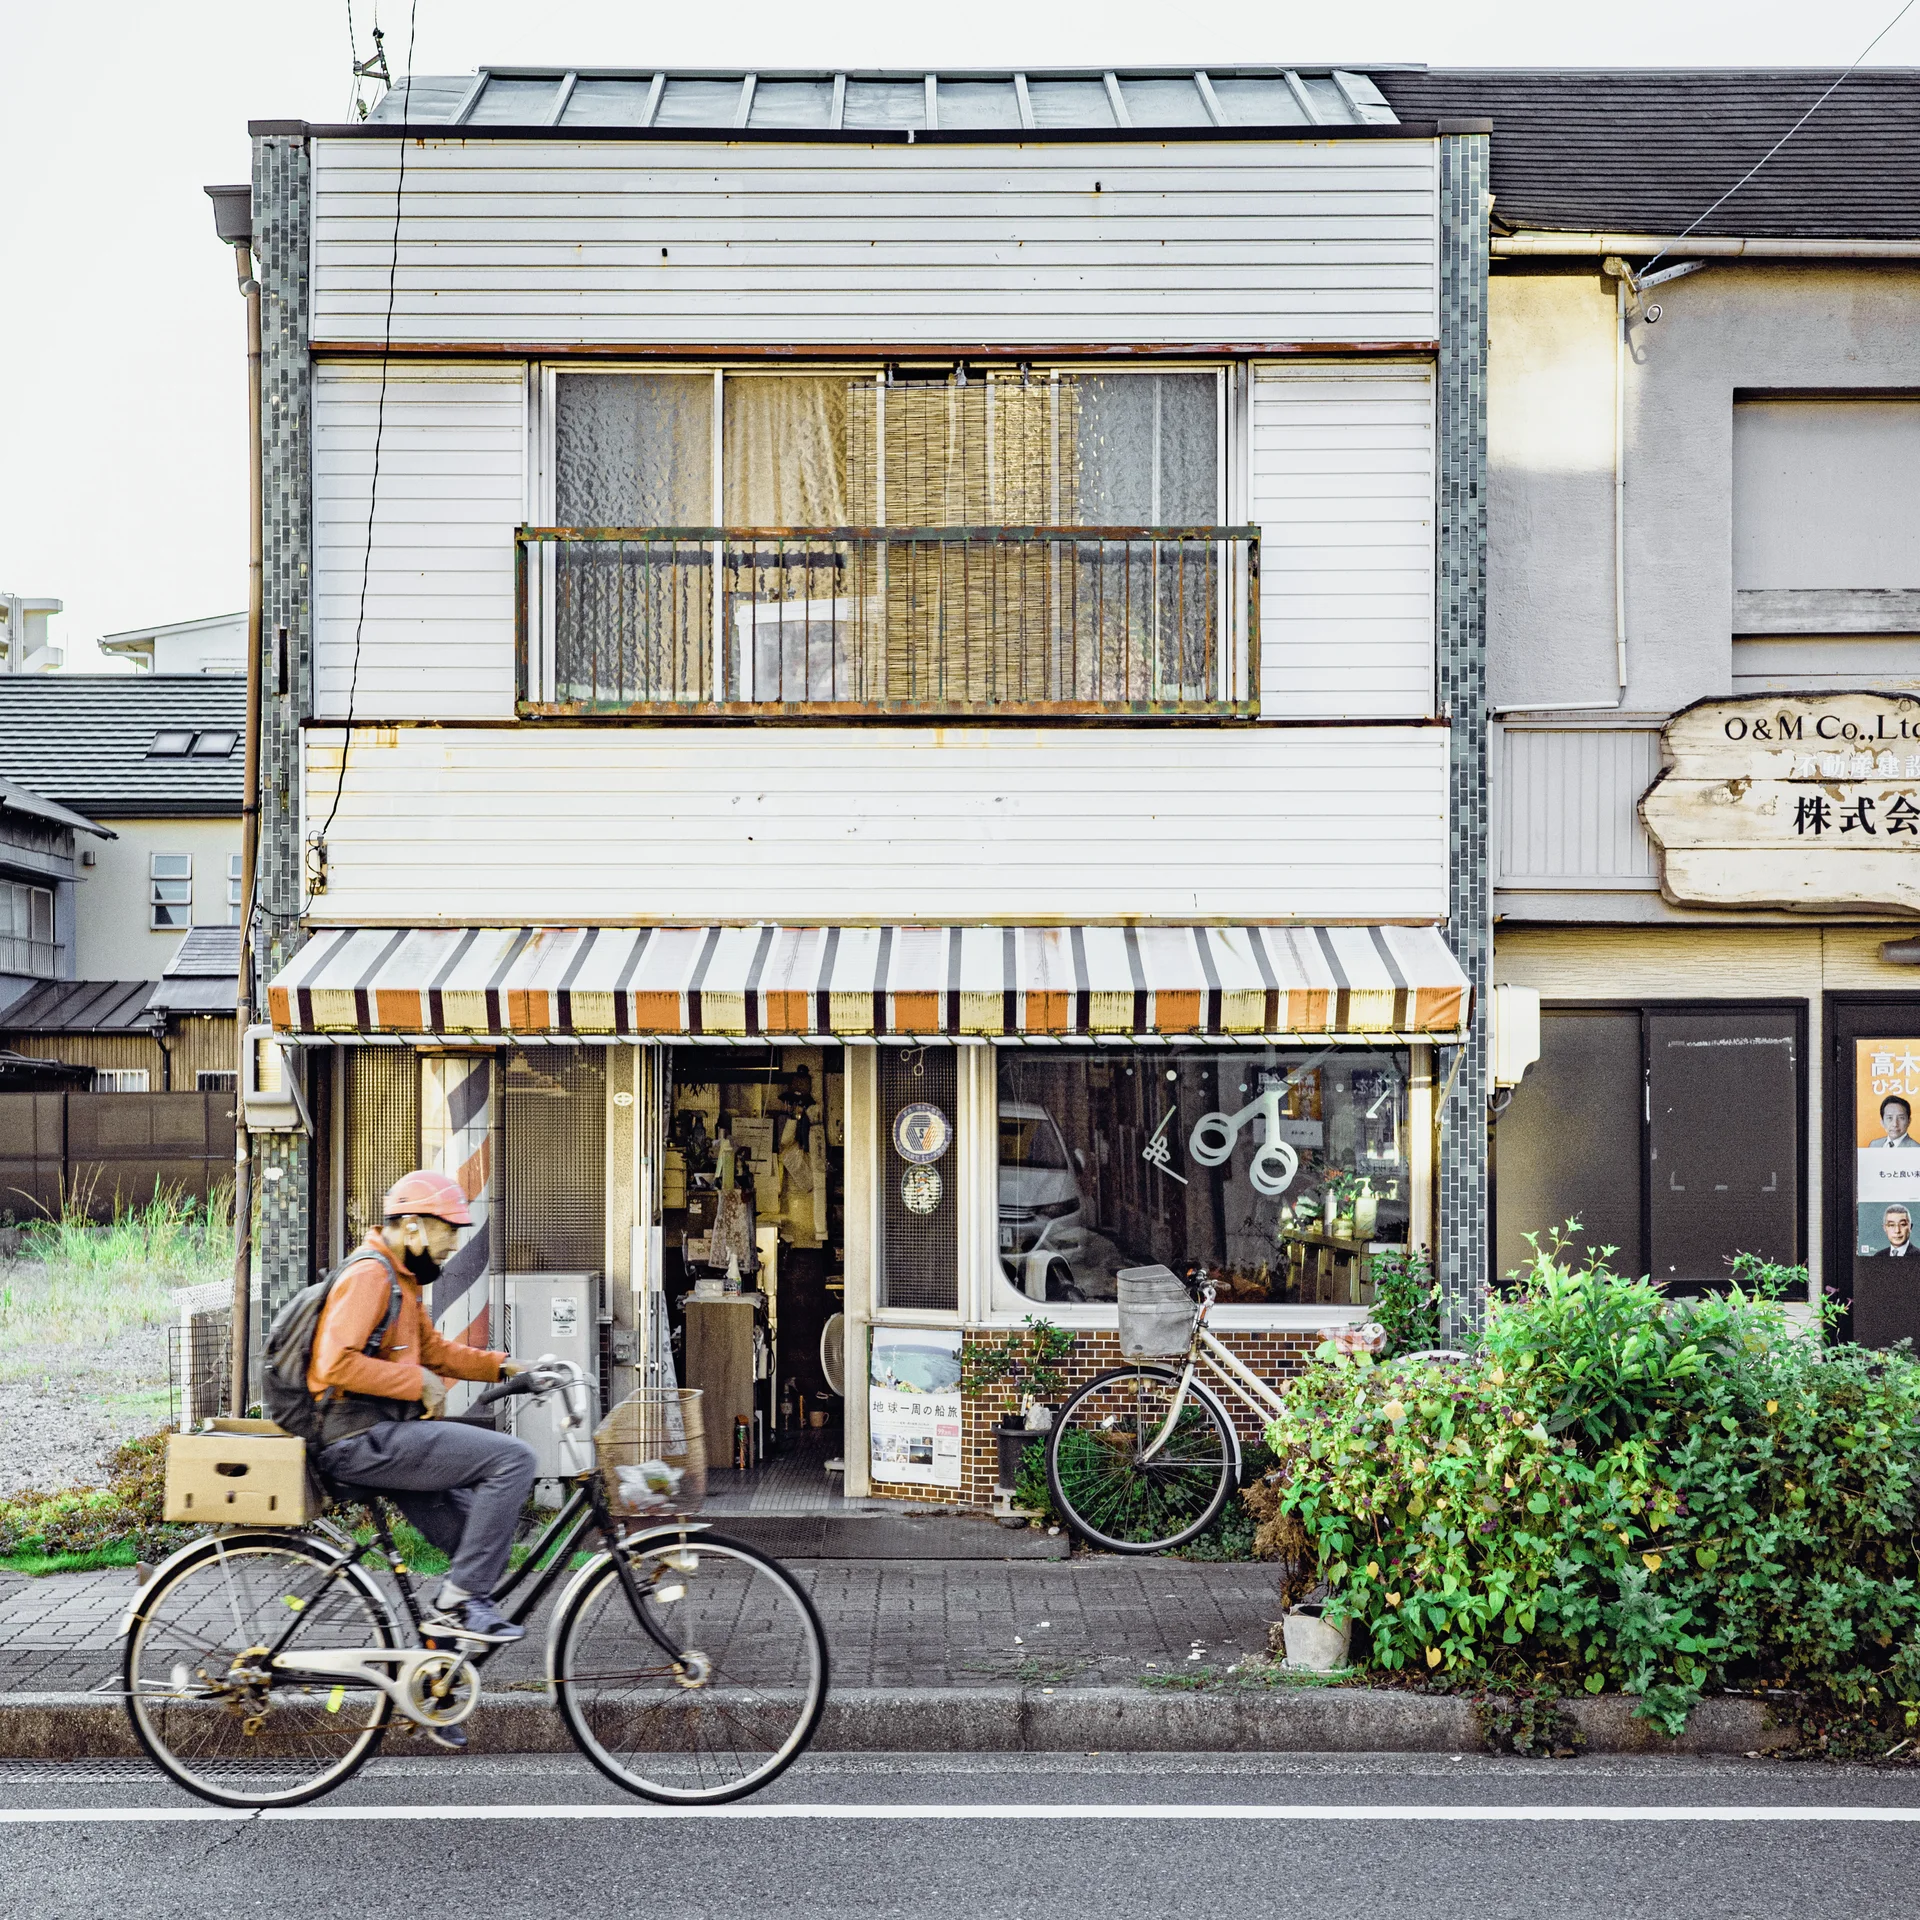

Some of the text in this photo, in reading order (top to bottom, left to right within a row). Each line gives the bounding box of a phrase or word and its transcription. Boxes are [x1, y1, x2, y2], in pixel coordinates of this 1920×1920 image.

[1724, 715, 1803, 741] O&M
[1793, 795, 1920, 835] 株式会
[1870, 1052, 1920, 1077] 高木
[1871, 1078, 1919, 1095] ひろし
[871, 1400, 959, 1418] 地球一周の船旅
